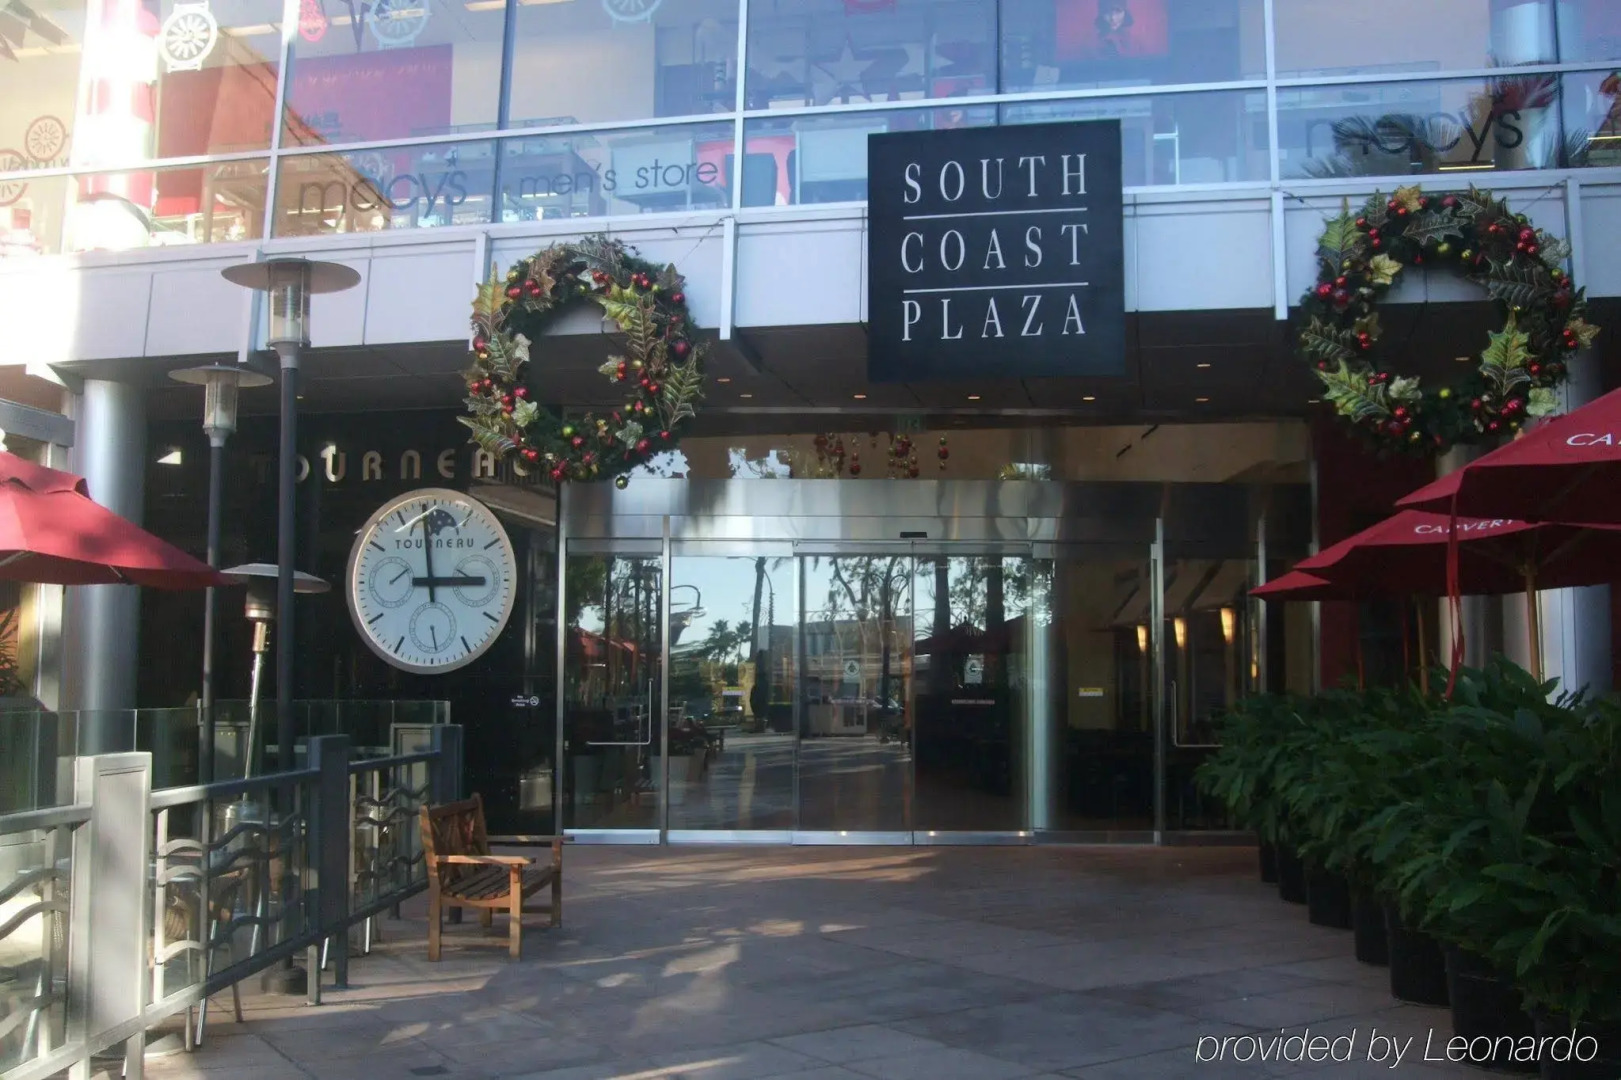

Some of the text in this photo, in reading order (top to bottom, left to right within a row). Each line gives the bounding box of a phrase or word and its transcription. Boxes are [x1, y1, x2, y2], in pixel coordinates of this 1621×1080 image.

[518, 165, 617, 198] men's
[634, 158, 719, 189] store
[903, 153, 1087, 203] SOUTH
[901, 223, 1089, 273] COAST
[901, 293, 1086, 342] PLAZA
[394, 537, 475, 549] TOUNEAU
